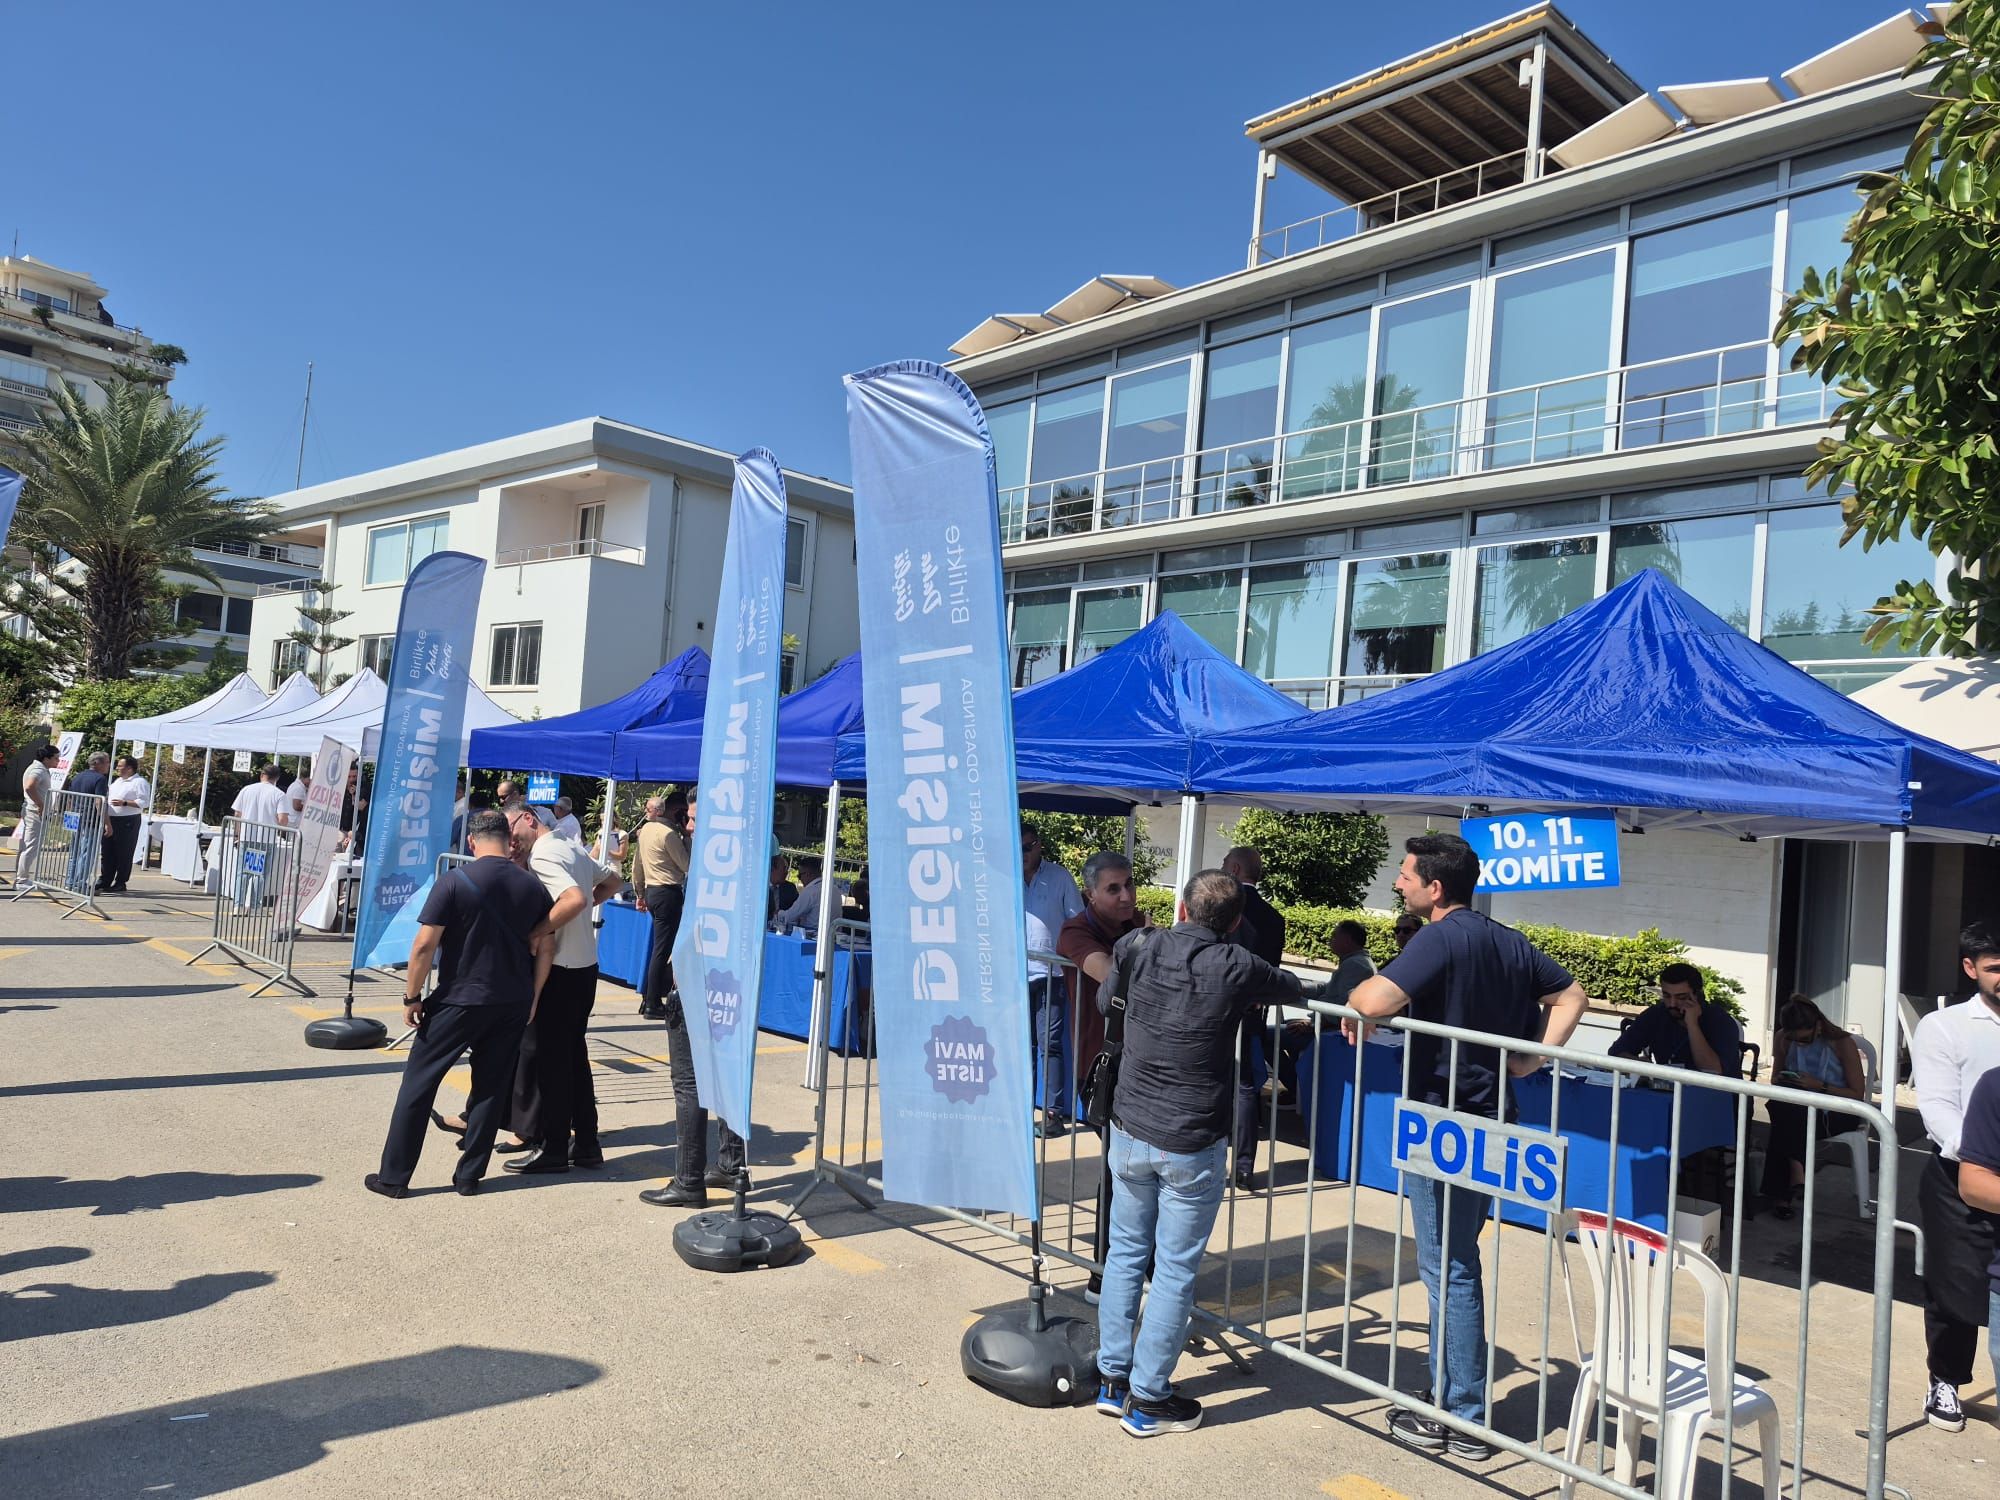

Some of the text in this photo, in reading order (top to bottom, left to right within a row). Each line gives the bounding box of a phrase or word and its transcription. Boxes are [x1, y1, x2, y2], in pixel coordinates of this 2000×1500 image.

[409, 629, 427, 679] Birlikte
[425, 643, 439, 675] Daha
[439, 642, 453, 680] Güçlü
[398, 708, 443, 866] DEĞİŞİM
[528, 785, 557, 801] KOMİTE
[1488, 817, 1584, 850] 10. 11.
[1476, 849, 1606, 887] KOMİTE
[382, 882, 412, 895] MAVİ
[382, 894, 411, 905] LİSTE
